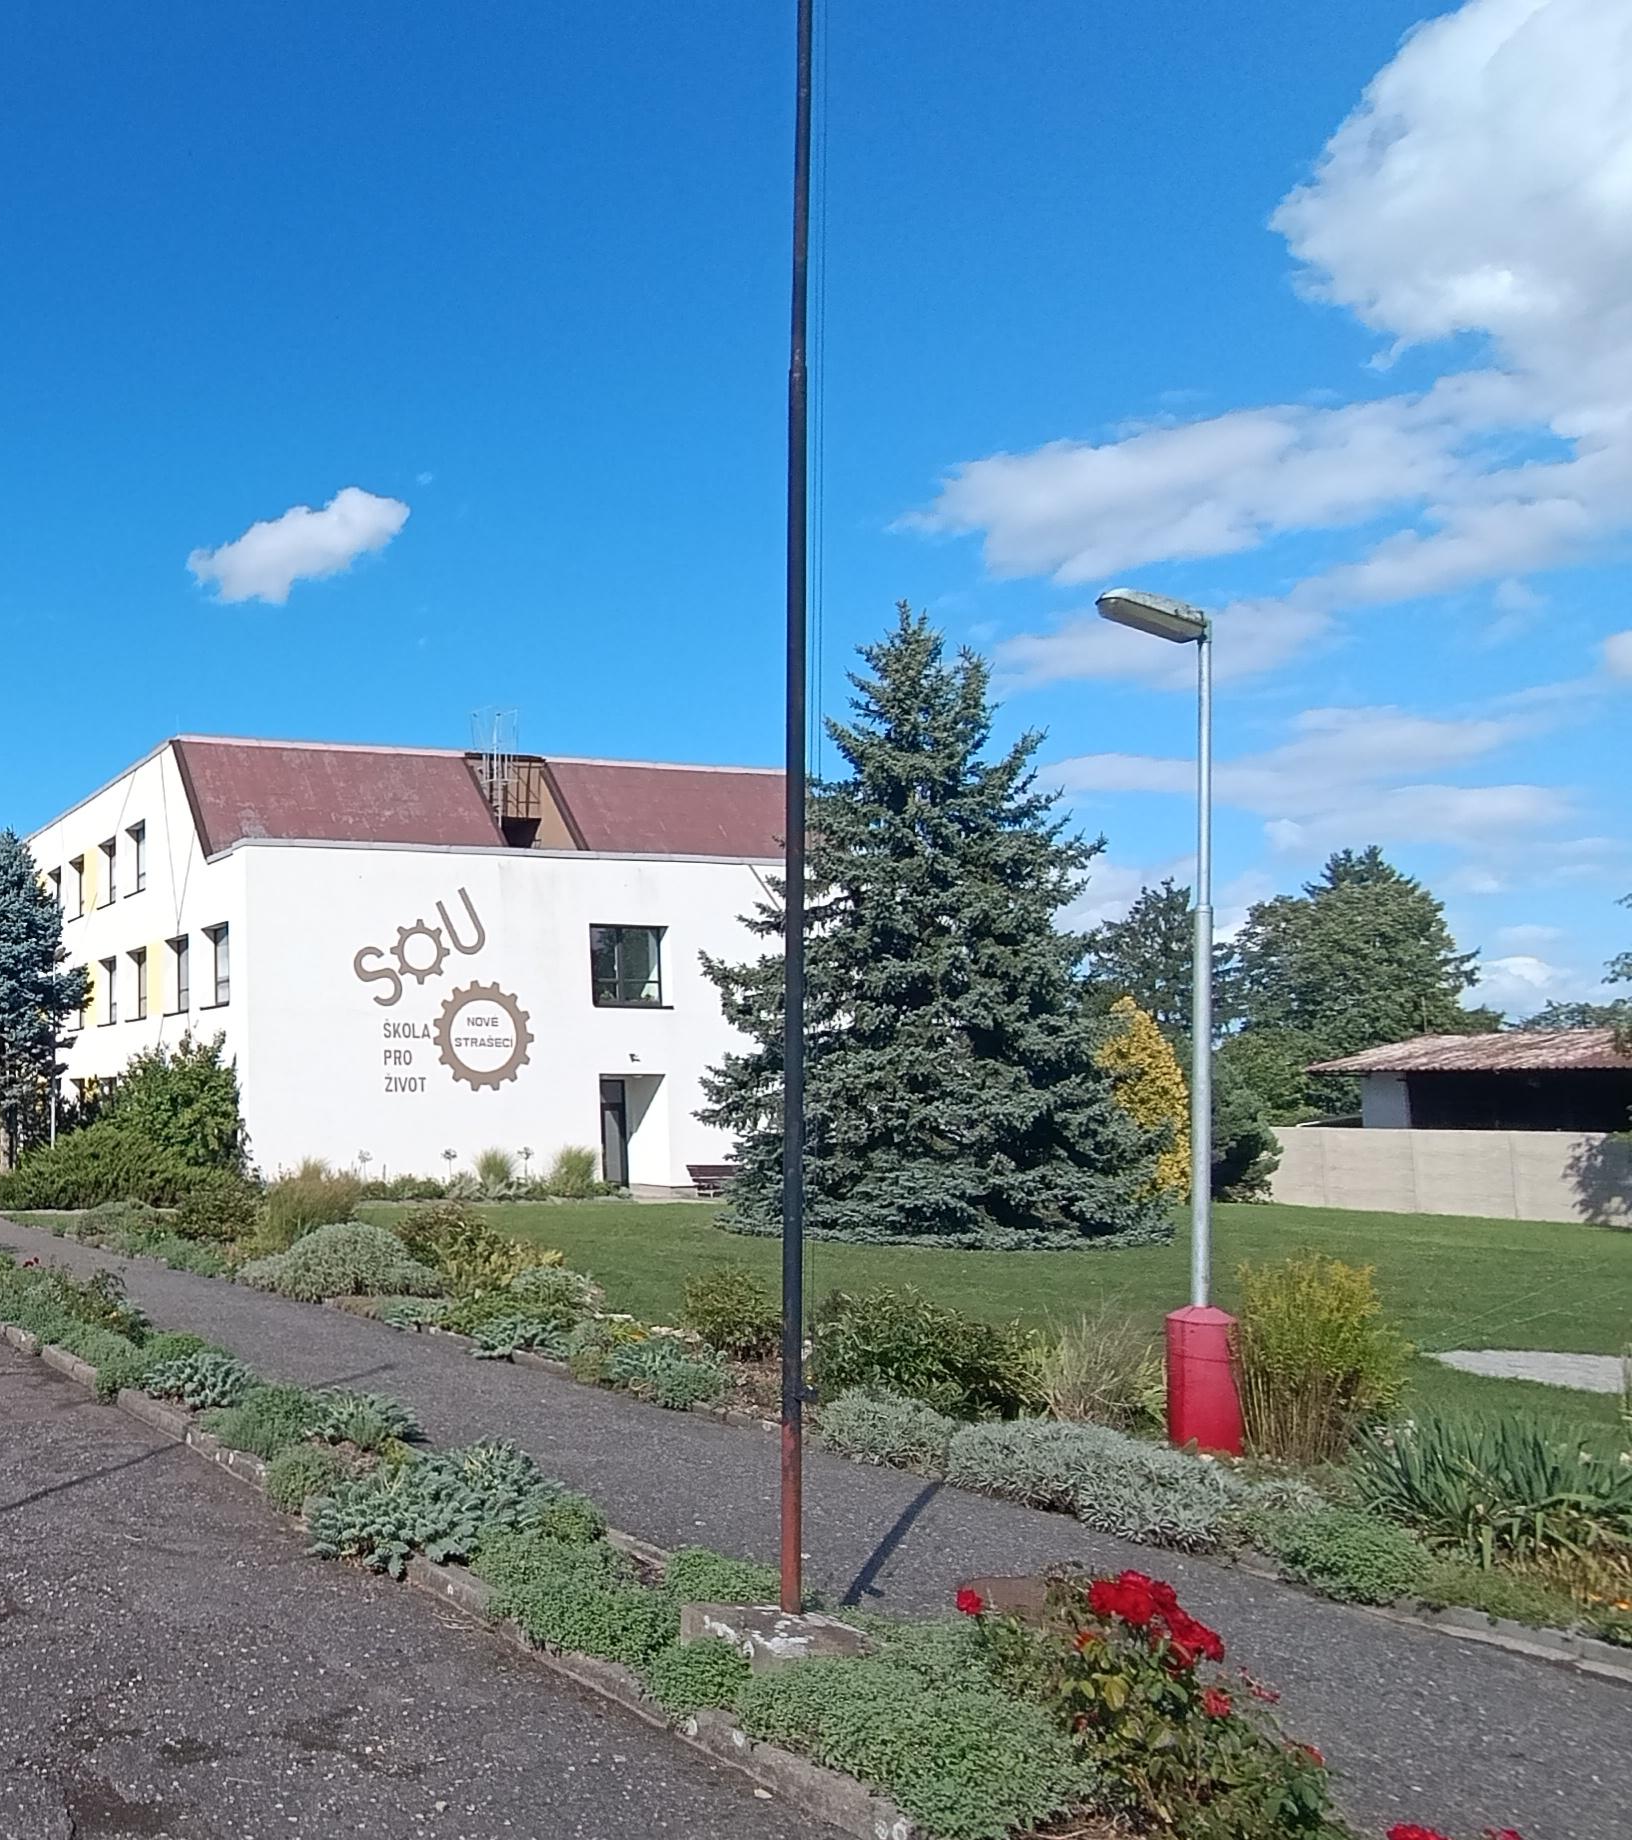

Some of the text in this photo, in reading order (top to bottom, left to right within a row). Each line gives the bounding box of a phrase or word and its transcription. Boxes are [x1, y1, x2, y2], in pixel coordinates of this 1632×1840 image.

[353, 886, 486, 1007] SOU
[383, 1018, 431, 1040] ŠKOLA
[383, 1049, 413, 1066] PRO
[384, 1073, 427, 1093] ŽIVOT
